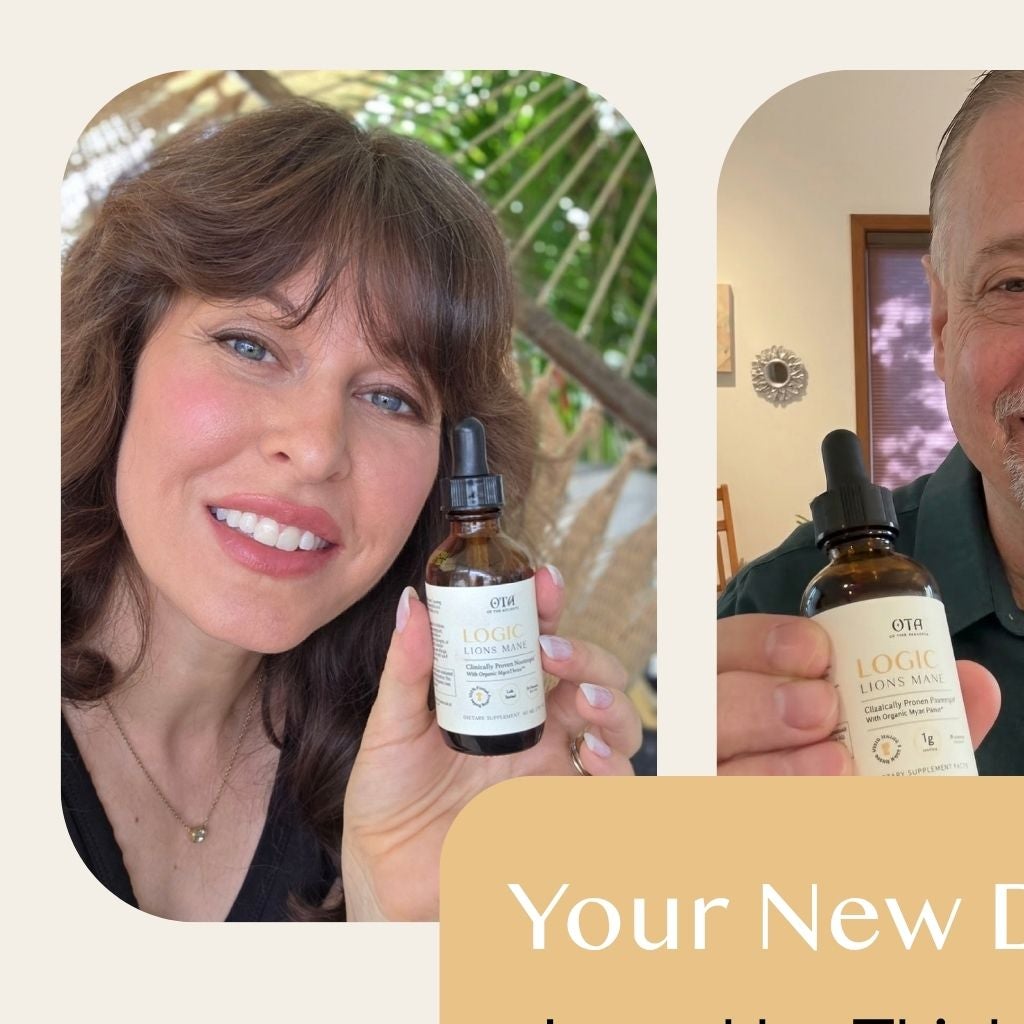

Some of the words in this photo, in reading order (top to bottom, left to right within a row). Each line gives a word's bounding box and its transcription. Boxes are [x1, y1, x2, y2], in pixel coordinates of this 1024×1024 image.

[892, 618, 923, 632] OTA
[463, 624, 523, 643] LOGIC
[464, 646, 497, 655] LIONS
[502, 640, 527, 652] MANE
[856, 649, 937, 678] LOGIC
[860, 676, 905, 694] LIONS
[911, 673, 944, 685] MANE
[866, 715, 881, 723] With
[882, 711, 907, 720] Organic
[921, 732, 935, 746] 1g
[907, 764, 952, 776] SUPPLEMENT
